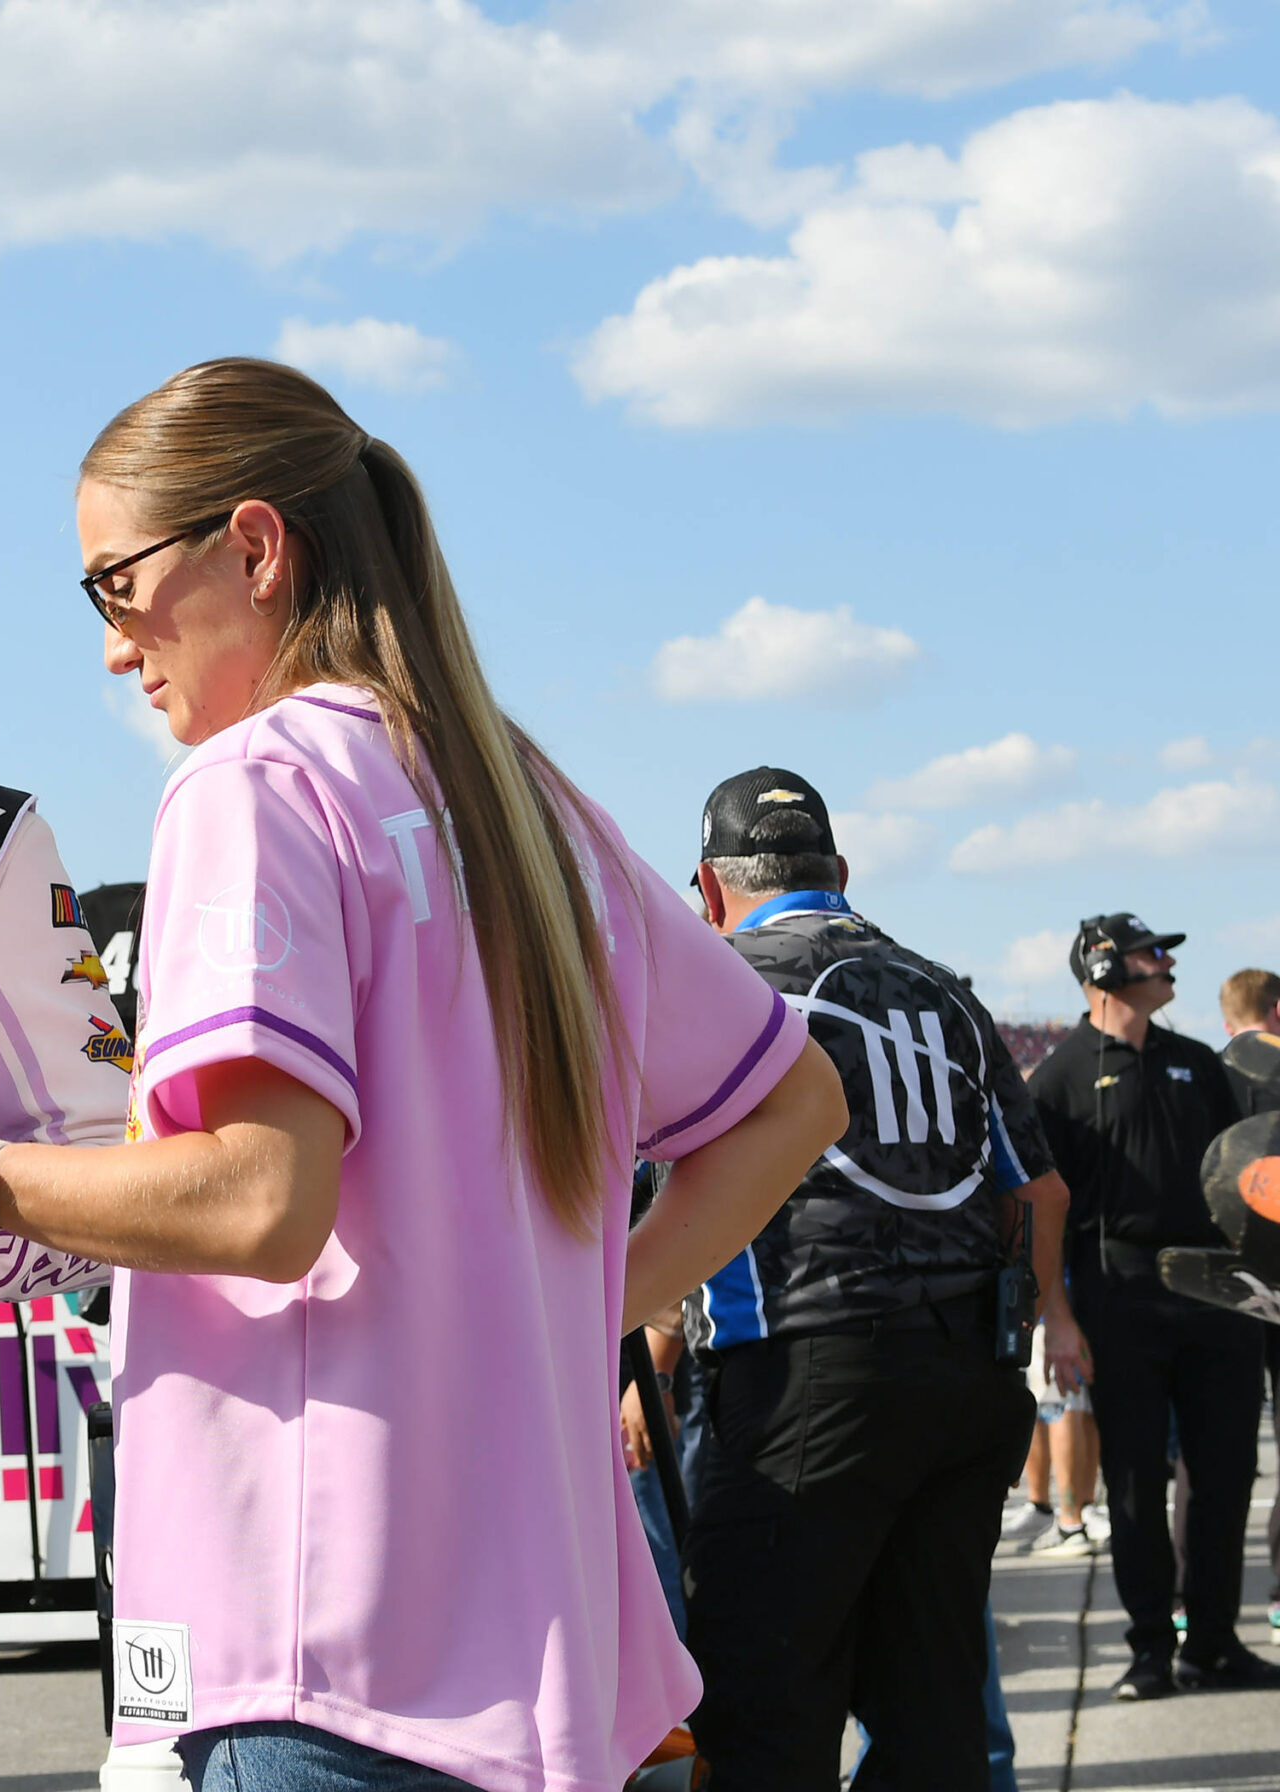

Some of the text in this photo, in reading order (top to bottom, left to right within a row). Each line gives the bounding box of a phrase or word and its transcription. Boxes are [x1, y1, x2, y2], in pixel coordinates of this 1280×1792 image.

[123, 1695, 184, 1708] TRACKHOUSE
[123, 1706, 184, 1721] ESTABLISHED 2021
